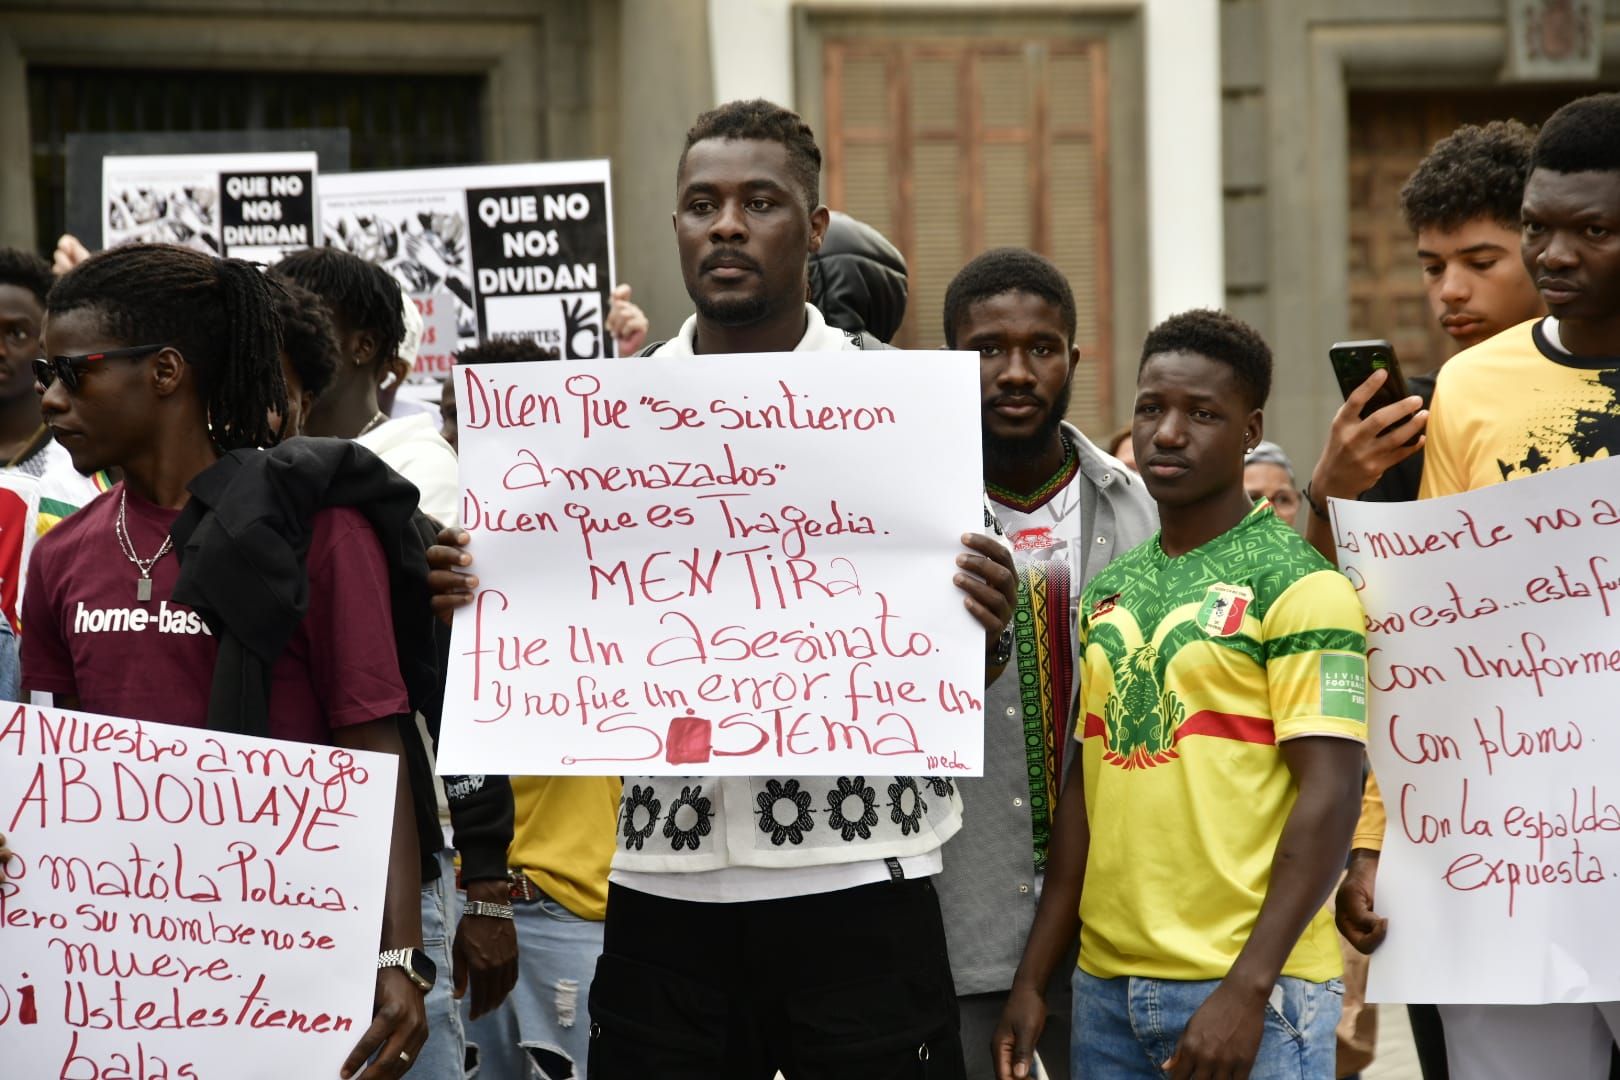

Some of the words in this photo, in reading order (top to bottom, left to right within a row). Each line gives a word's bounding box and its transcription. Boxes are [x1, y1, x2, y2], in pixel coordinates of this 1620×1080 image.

[226, 176, 269, 200] QUE
[271, 175, 304, 197] NO
[241, 200, 283, 222] NOS
[478, 195, 538, 227] QUE
[543, 193, 590, 221] NO
[223, 224, 307, 245] DIVIDAN
[502, 230, 559, 258] NOS
[478, 263, 598, 294] DIVIDAN
[465, 367, 561, 430] Dicen
[464, 488, 559, 532] Dicen
[647, 503, 695, 528] es
[1364, 509, 1513, 559] muerte
[1525, 508, 1582, 534] no
[462, 589, 550, 701] fue
[575, 675, 630, 725] fue
[0, 704, 27, 756] A
[196, 738, 370, 812] amigo
[9, 757, 358, 856] ABDOULAYE
[1504, 785, 1620, 862] espalda
[261, 928, 296, 951] no
[298, 930, 336, 950] se
